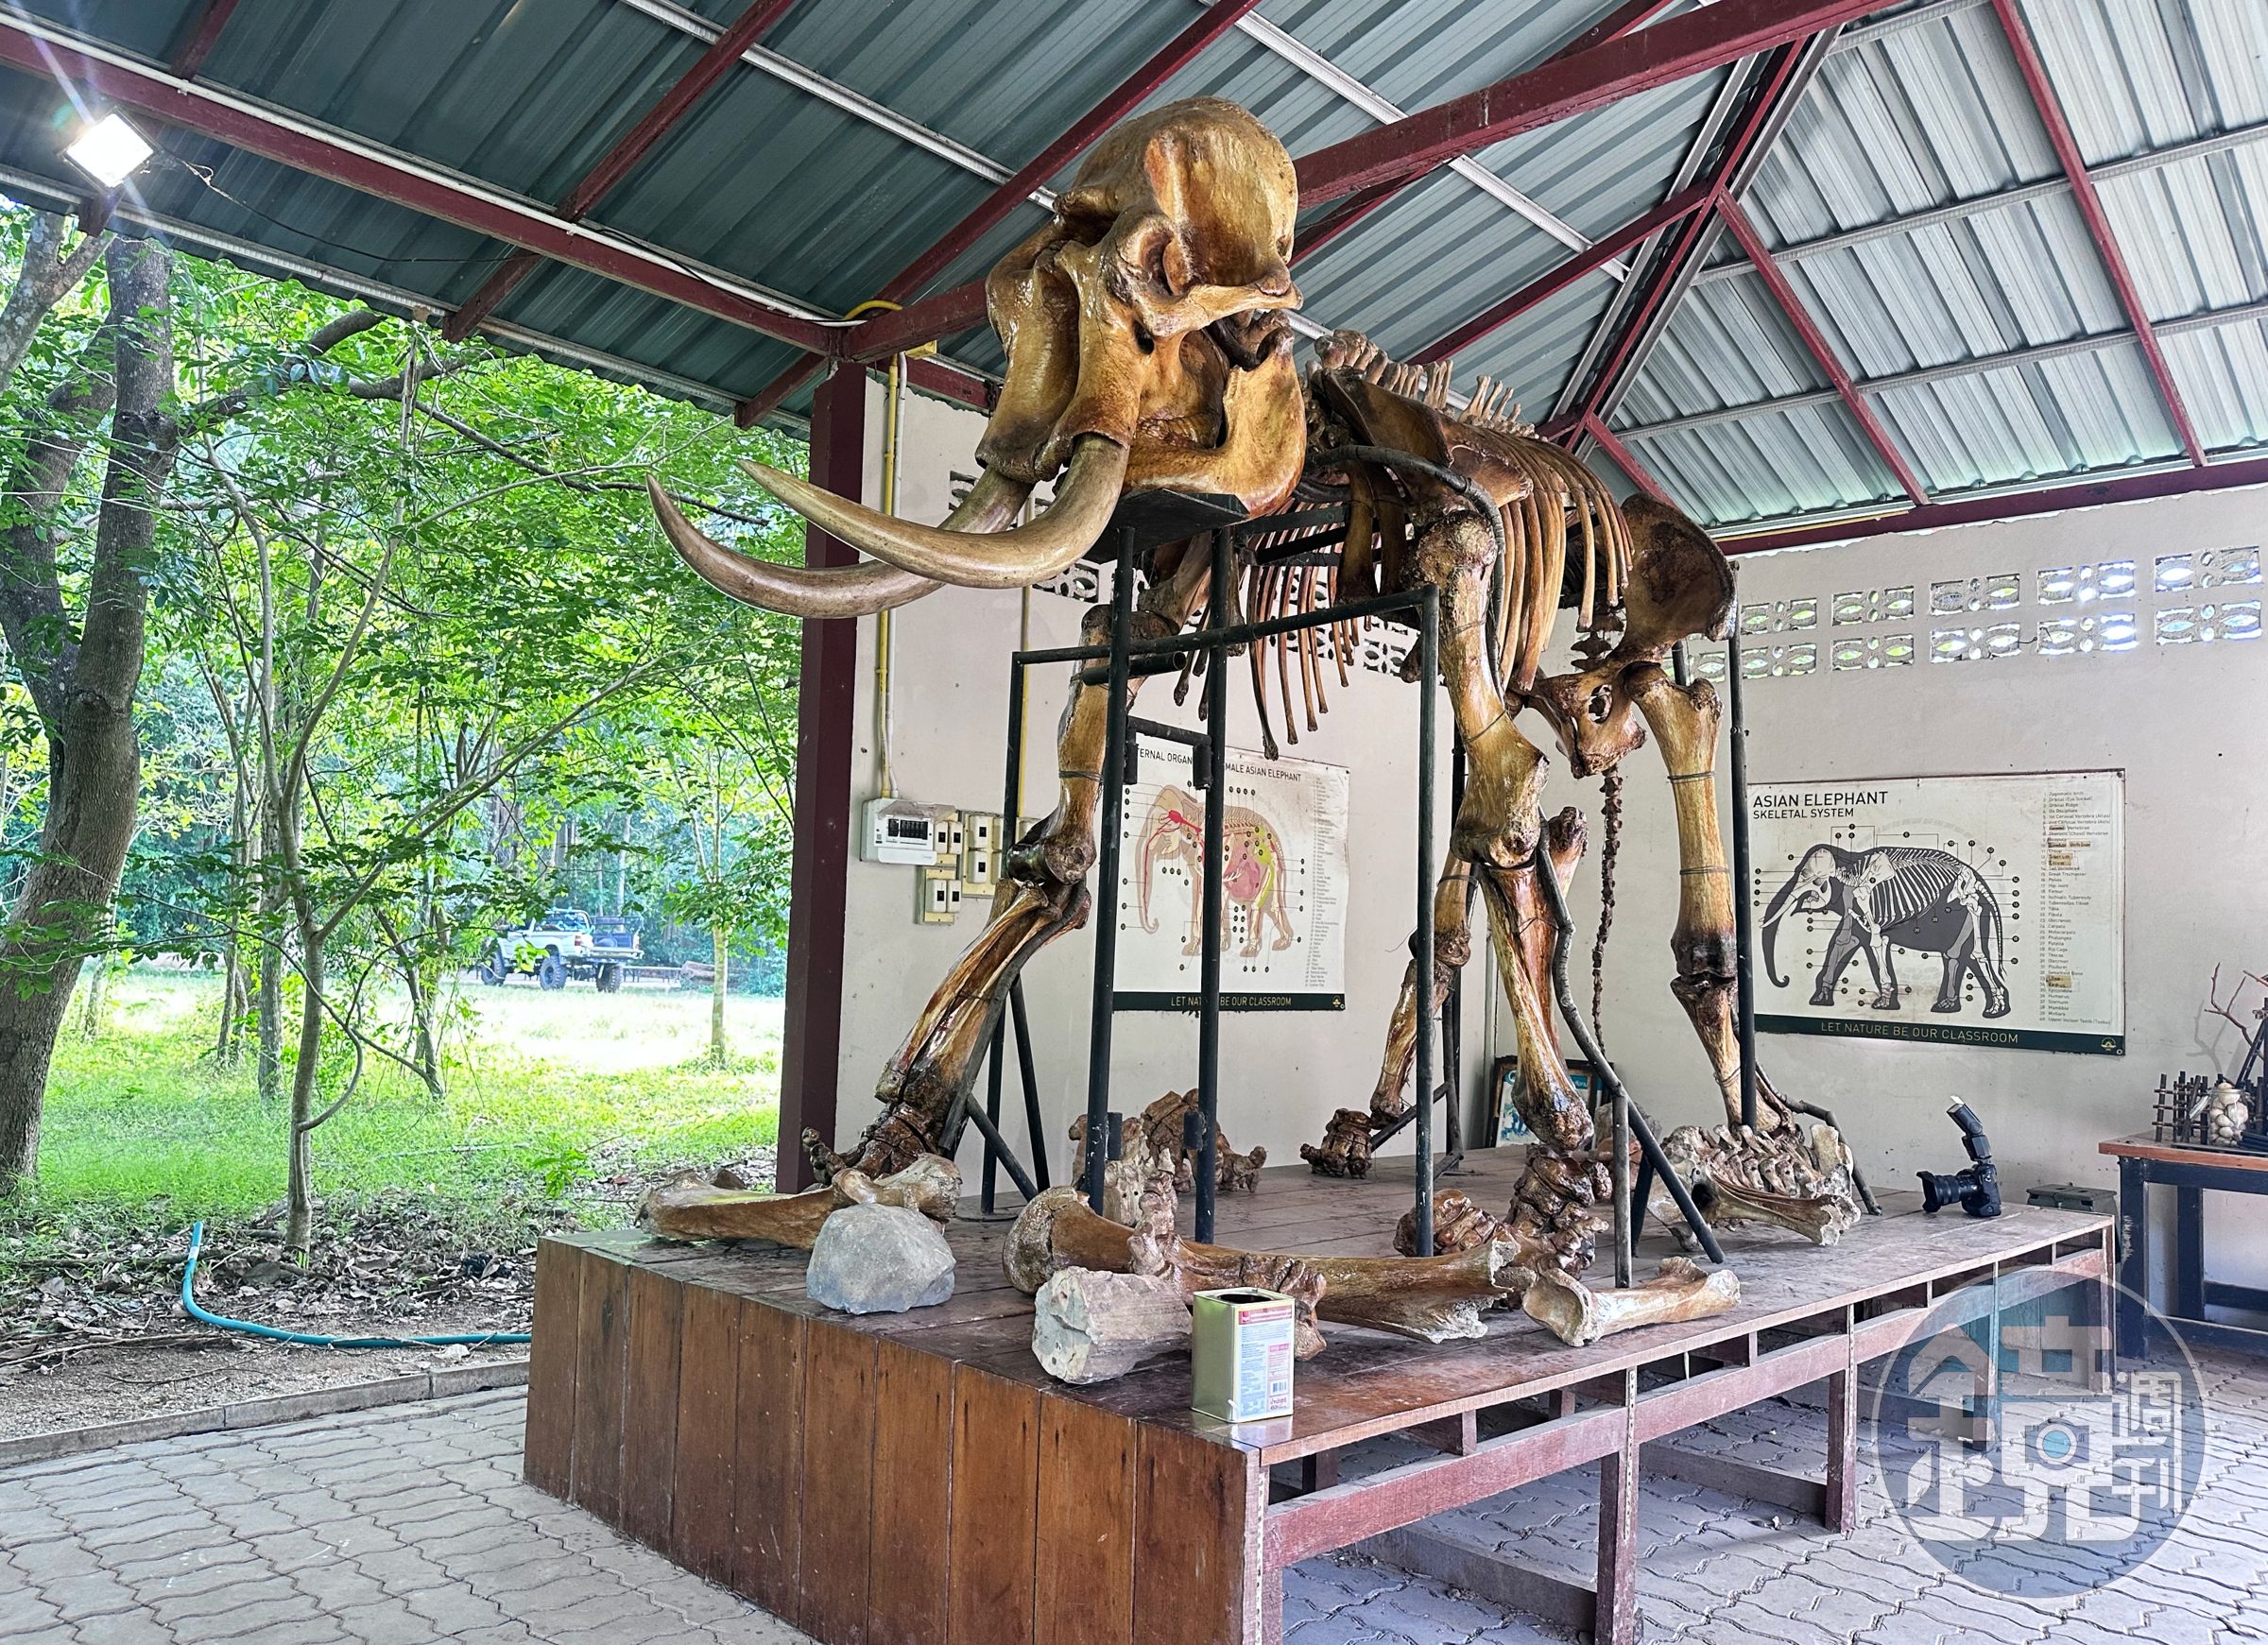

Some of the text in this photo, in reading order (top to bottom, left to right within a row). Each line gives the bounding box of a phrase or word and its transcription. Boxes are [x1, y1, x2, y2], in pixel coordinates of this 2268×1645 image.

[1138, 748, 1165, 761] ERNAL
[1167, 752, 1193, 764] ORGAN
[1246, 764, 1266, 776] ASIAN
[1268, 769, 1301, 781] ELEPHANT
[1753, 792, 1888, 807] ASIAN ELEPHANT
[1754, 808, 1854, 819] SKELETAL SYSTEM
[1171, 996, 1292, 1006] LET NAT BE OUR CLASSROOM
[1821, 1022, 2019, 1043] LET NATURE BE OUR CLASSROOM
